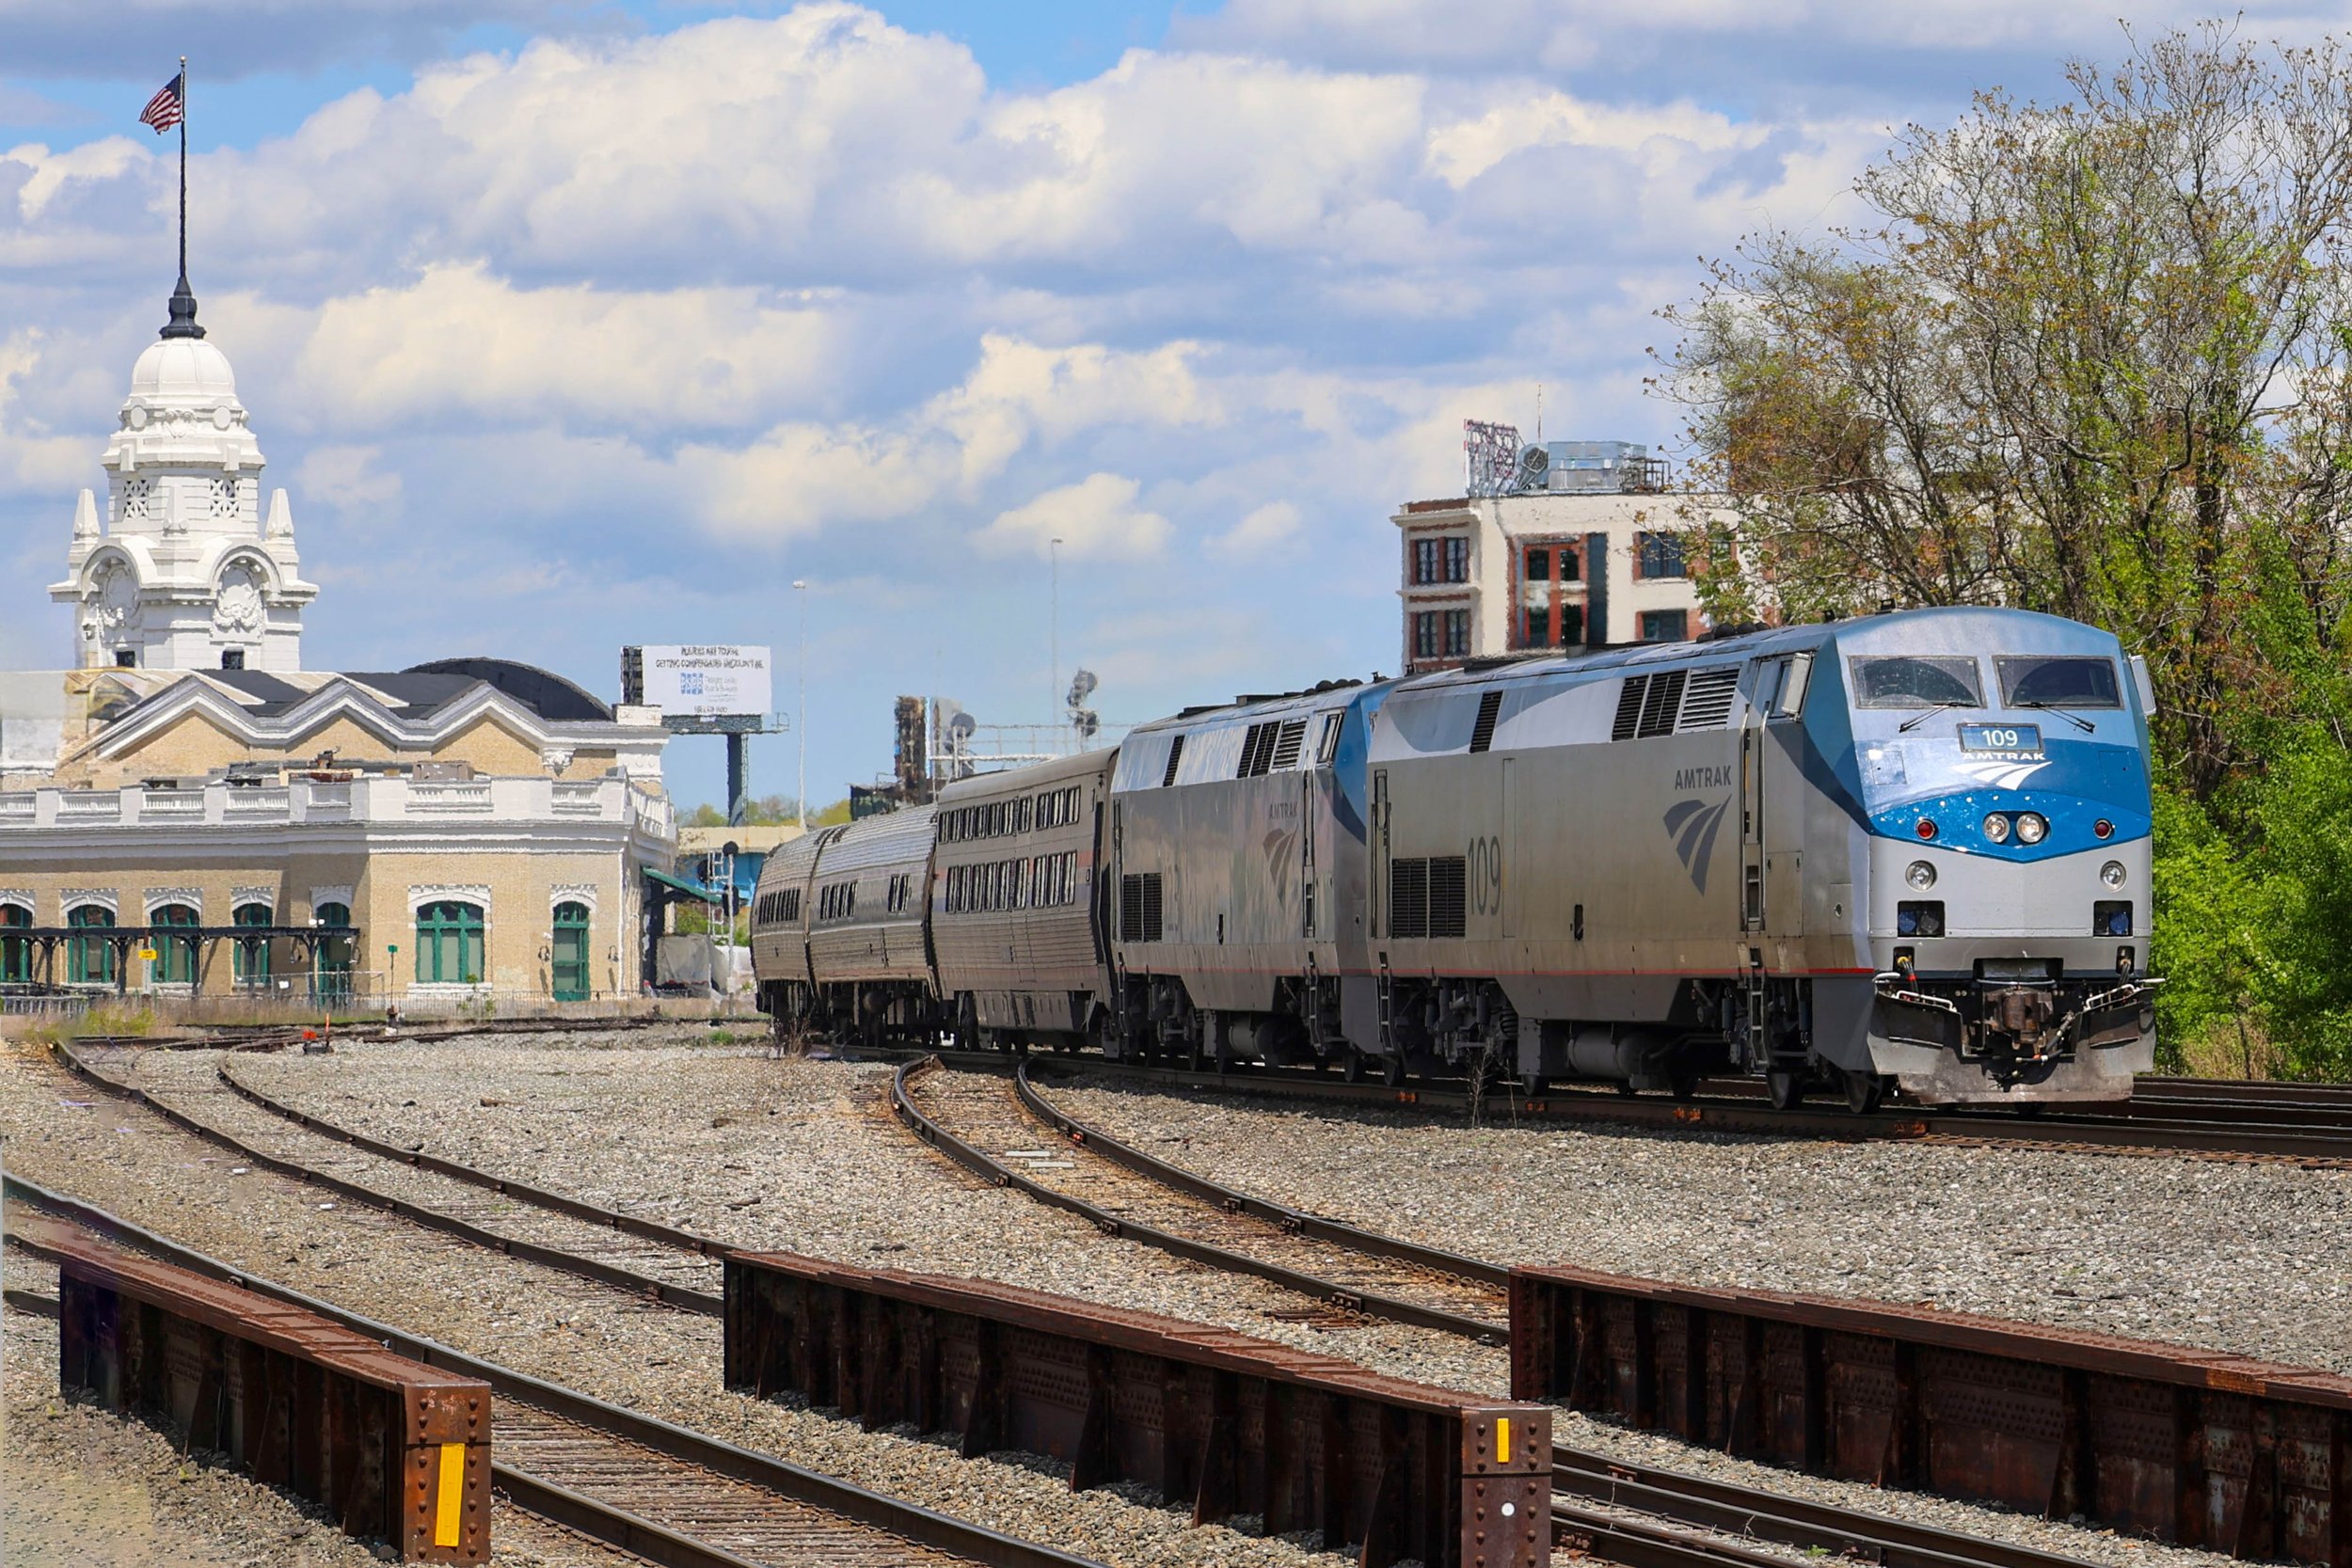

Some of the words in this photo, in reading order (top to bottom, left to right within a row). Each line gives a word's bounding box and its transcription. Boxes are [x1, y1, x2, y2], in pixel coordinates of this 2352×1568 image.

[1981, 729, 2018, 747] 109
[1962, 752, 2046, 761] AMTRAK
[1674, 765, 1732, 791] AMTRAK
[1268, 800, 1298, 820] AMTRAK
[1468, 835, 1502, 917] 109
